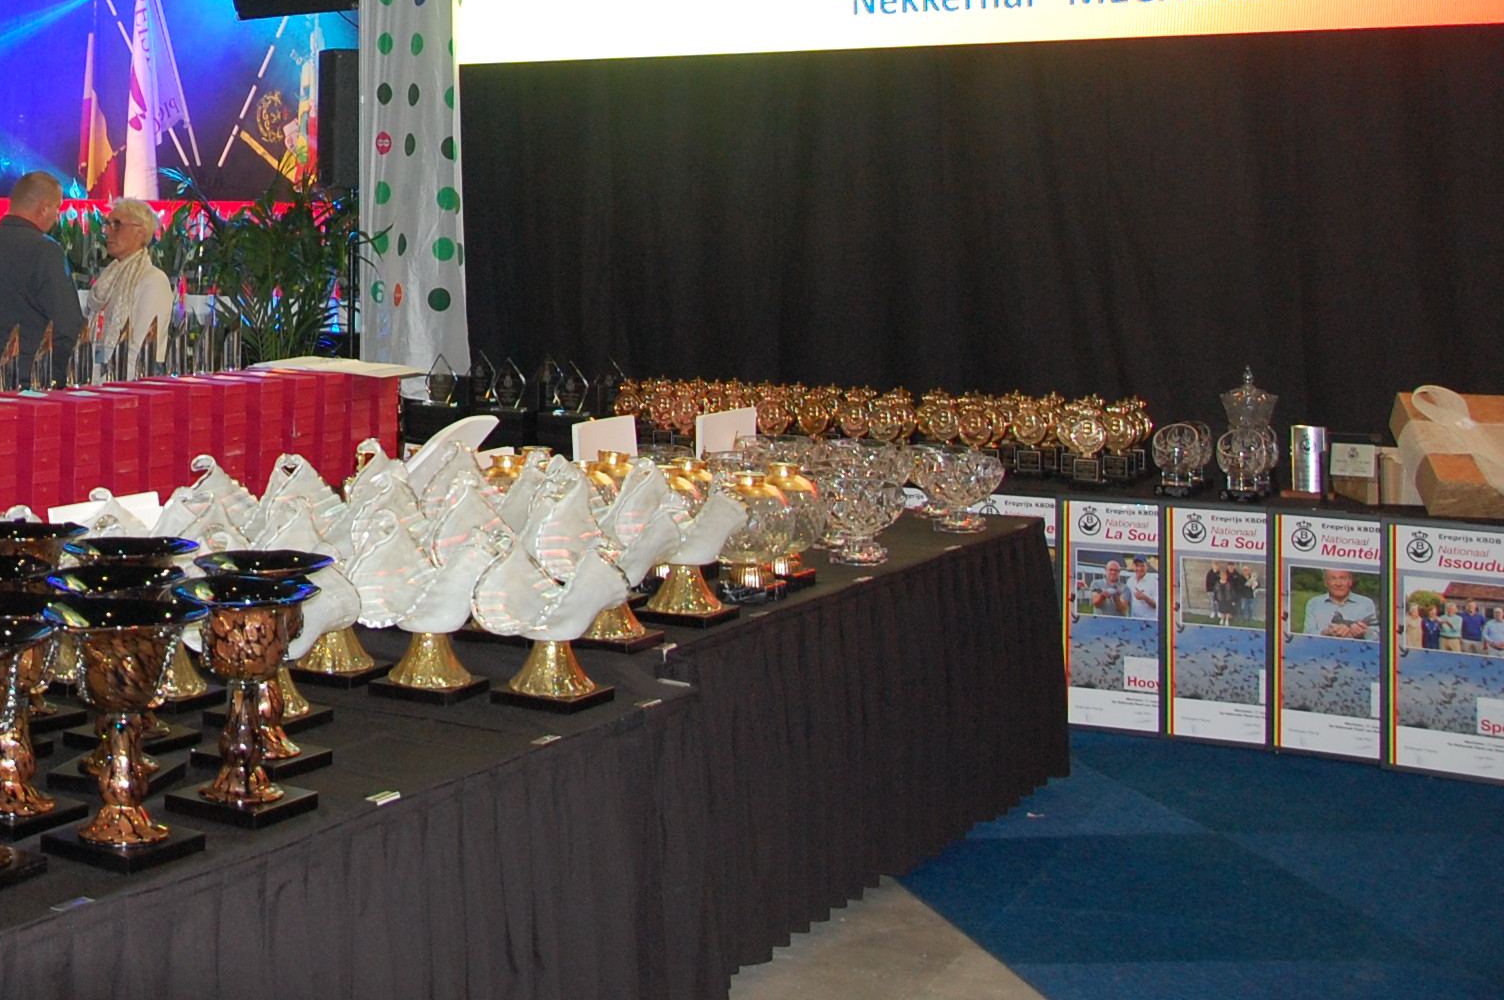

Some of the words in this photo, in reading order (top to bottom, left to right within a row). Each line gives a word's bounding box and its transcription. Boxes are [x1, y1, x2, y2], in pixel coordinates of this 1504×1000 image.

[1105, 518, 1149, 529] Nationaal
[1105, 528, 1123, 540] La
[1128, 530, 1157, 542] Sou
[1211, 526, 1257, 537] Nationaal
[1211, 536, 1229, 548] La
[1234, 537, 1265, 551] Sou
[1321, 534, 1369, 546] Nationaal
[1321, 543, 1380, 561] Montél
[1438, 545, 1489, 558] Nationaal
[1480, 719, 1504, 736] Sp
